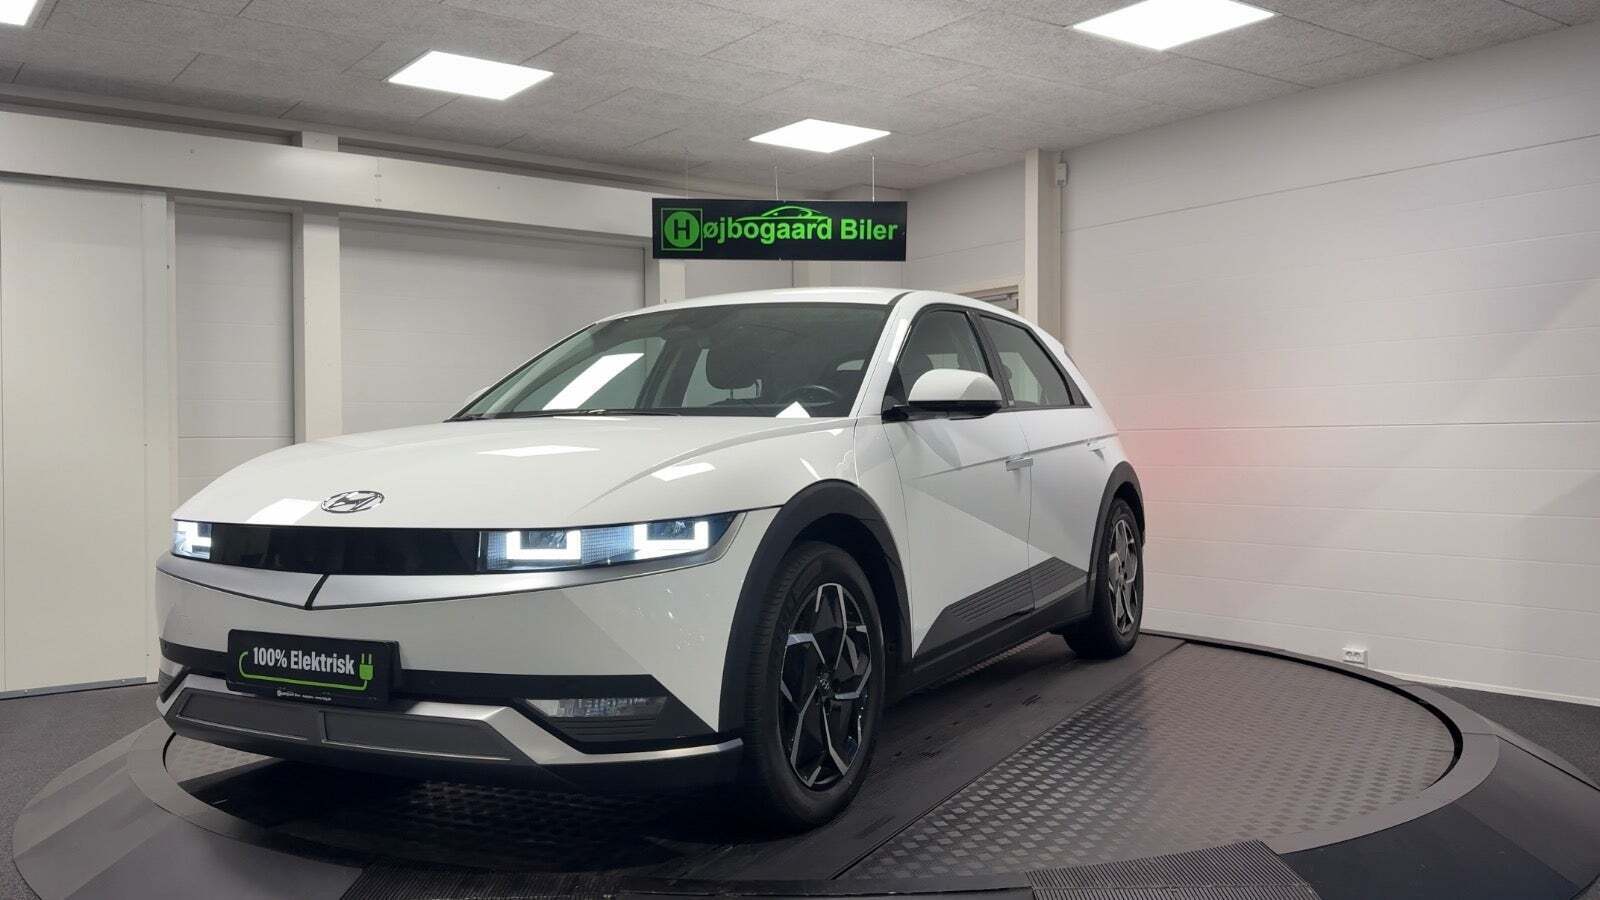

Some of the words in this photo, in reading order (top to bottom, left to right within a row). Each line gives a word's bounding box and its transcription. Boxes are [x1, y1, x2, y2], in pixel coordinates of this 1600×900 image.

[841, 219, 898, 241] Biler
[253, 646, 288, 668] 100%
[290, 649, 354, 675] Elektrisk
